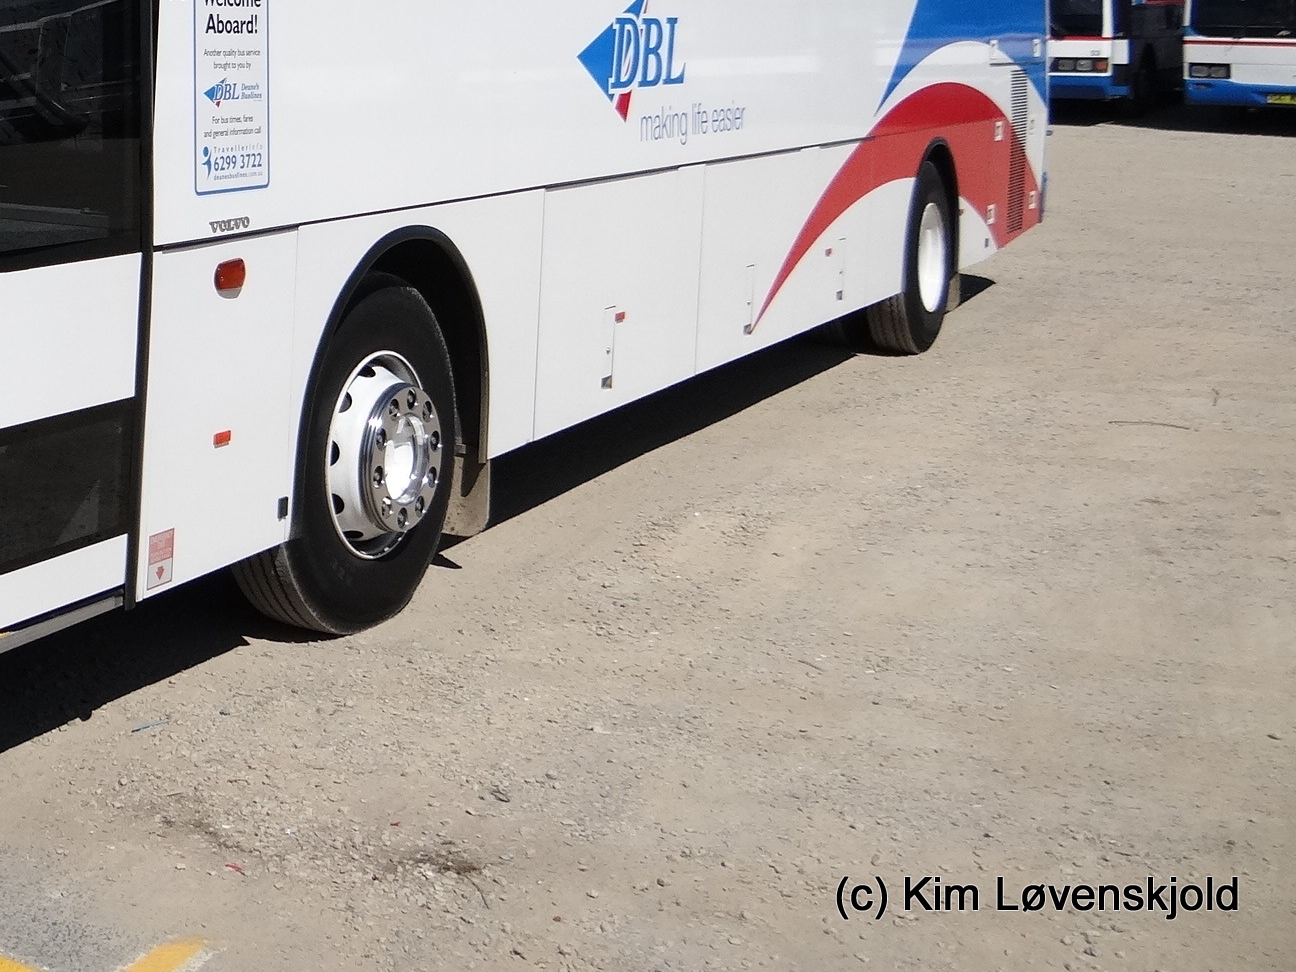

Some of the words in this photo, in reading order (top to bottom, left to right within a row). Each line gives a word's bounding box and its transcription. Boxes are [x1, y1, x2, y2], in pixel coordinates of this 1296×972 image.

[205, 13, 258, 34] Aboard!
[610, 17, 686, 89] DBL
[213, 61, 230, 71] brought
[237, 62, 245, 70] you
[246, 61, 251, 70] by
[214, 83, 239, 100] DBL
[212, 116, 220, 124] For
[640, 105, 688, 145] making
[692, 102, 708, 135] life
[711, 100, 745, 133] easier
[204, 129, 212, 137] and
[213, 129, 228, 139] general
[230, 127, 253, 135] information
[214, 155, 237, 171] 6299
[240, 152, 262, 169] 3722
[209, 217, 250, 233] VOLVO
